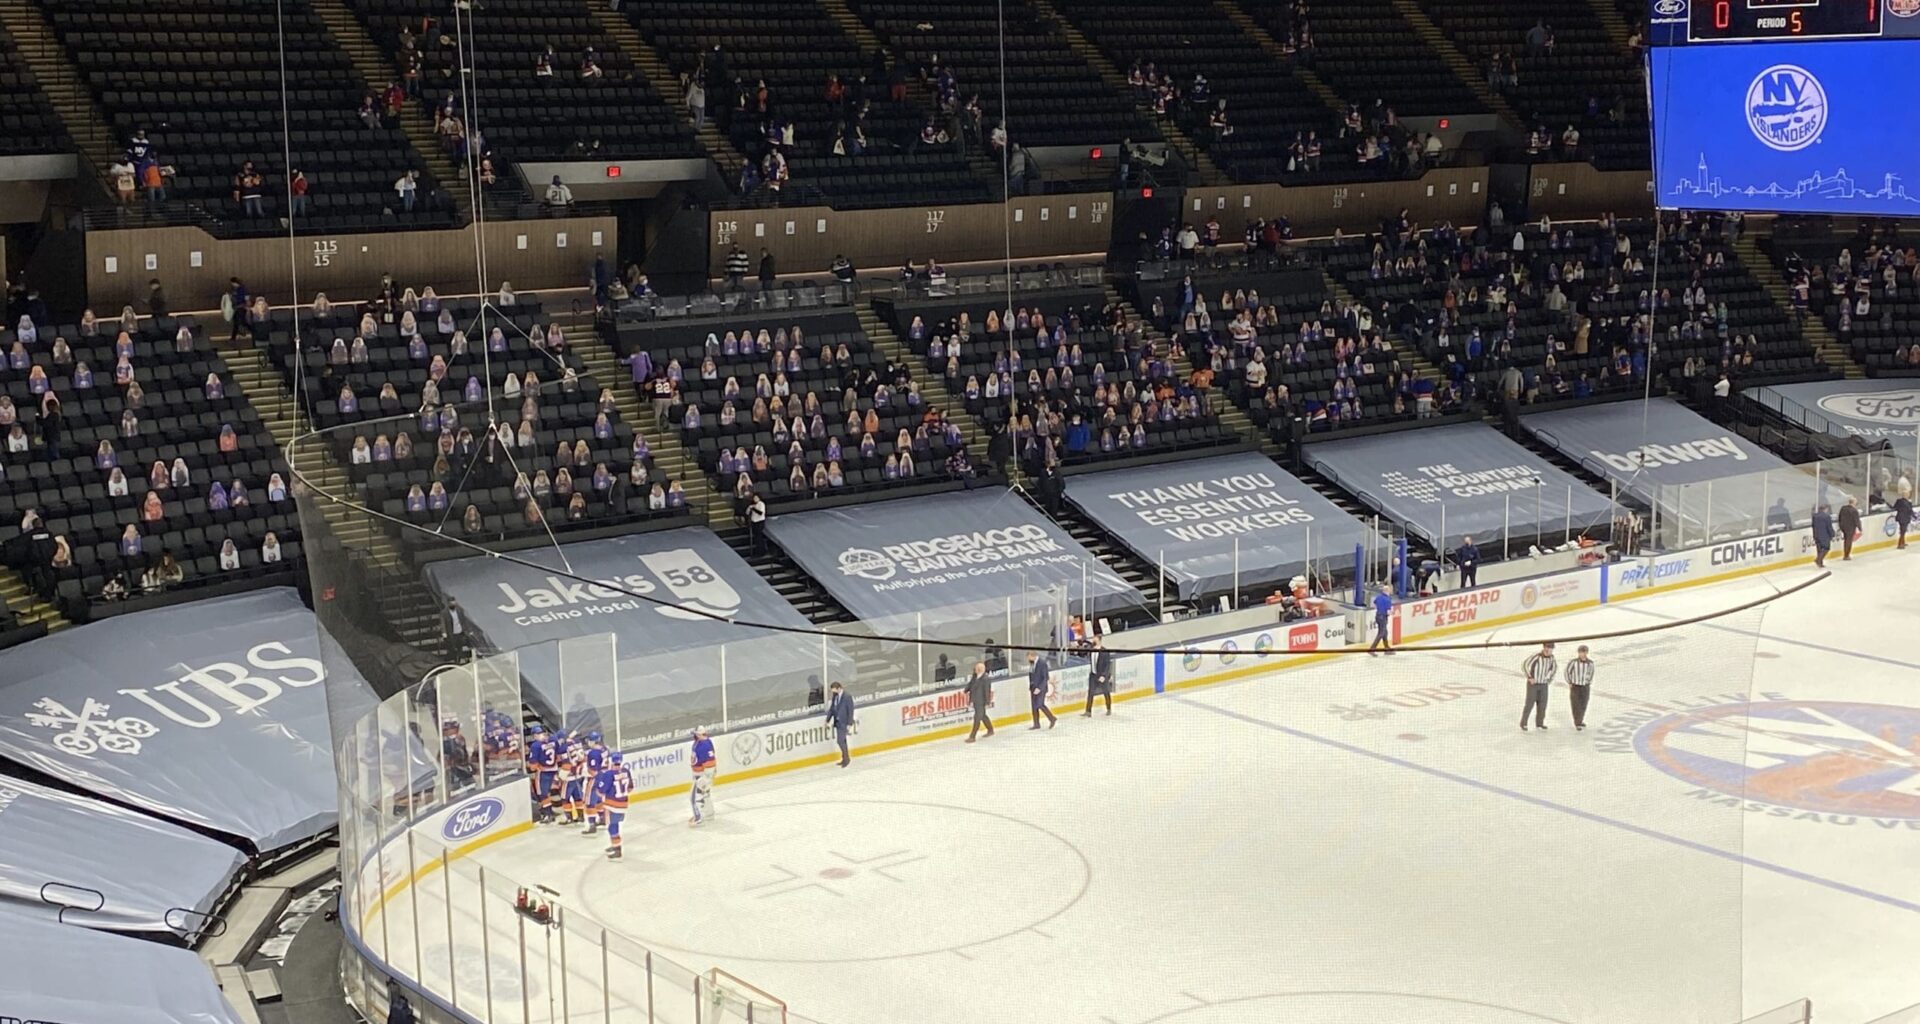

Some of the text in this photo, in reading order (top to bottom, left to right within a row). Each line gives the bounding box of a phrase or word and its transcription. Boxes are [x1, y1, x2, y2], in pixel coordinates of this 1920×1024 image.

[1716, 2, 1729, 28] 0
[1757, 12, 1802, 32] PERIOD 5
[1756, 114, 1817, 143] ISLANDERS
[718, 221, 737, 232] 116
[926, 223, 938, 233] 17
[927, 211, 944, 221] 117
[314, 240, 337, 253] 115
[718, 234, 730, 245] 16
[314, 255, 330, 266] 15
[1856, 395, 1920, 418] For
[1590, 436, 1748, 471] betway
[1417, 463, 1461, 478] THE
[1434, 464, 1542, 488] BOUNTIFUL
[1108, 472, 1276, 509] THANK YOU
[1452, 476, 1547, 498] COMPANY
[1136, 491, 1300, 526] ESSENTIAL
[1164, 507, 1315, 542] WORKERS
[882, 524, 1048, 561] RIDGEWOOD
[1711, 536, 1784, 566] CON-KEL
[900, 538, 1064, 574] SAVINGS BANK
[873, 573, 947, 593] Multiplying
[947, 570, 967, 581] the
[968, 564, 1005, 577] Good
[1004, 562, 1023, 570] for
[497, 565, 715, 615] Jake's 58
[514, 600, 640, 626] Casino Hotel
[1411, 589, 1500, 618] PC RICHARD
[1434, 608, 1477, 627] & SON
[1291, 632, 1316, 646] TORO
[117, 641, 328, 728] UBS
[1376, 682, 1487, 708] UBS
[902, 700, 935, 720] Parts
[1670, 692, 1785, 708] LIVE
[545, 749, 555, 765] 3
[621, 748, 684, 771] orthwell
[613, 779, 630, 798] 17
[453, 804, 492, 836] Ford
[1683, 789, 1857, 827] NASSAU
